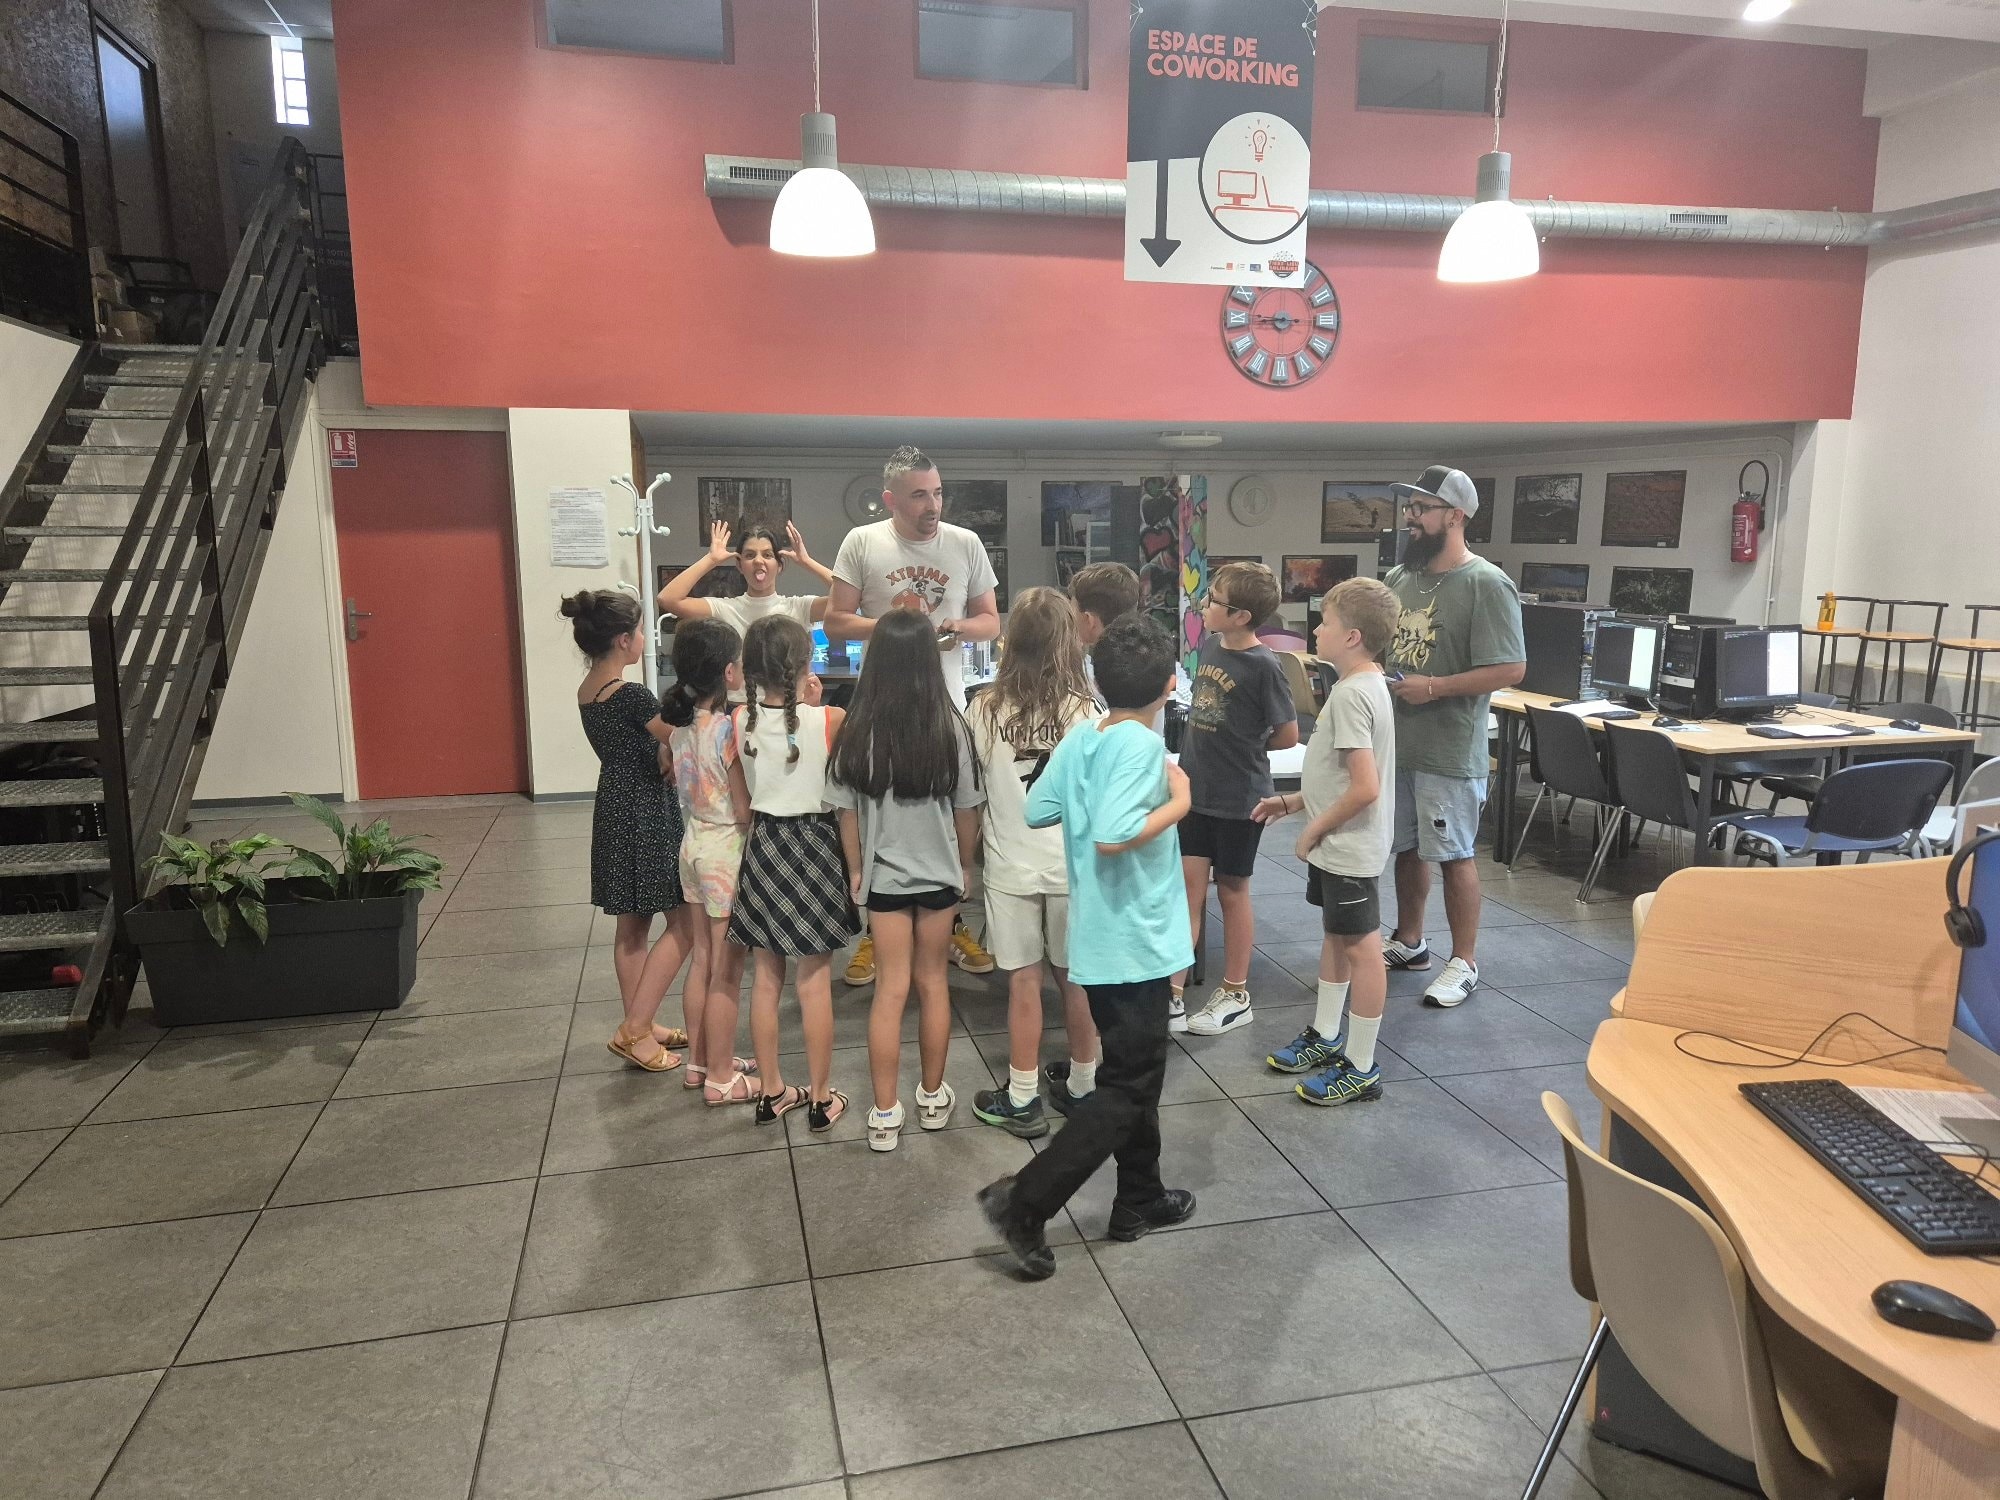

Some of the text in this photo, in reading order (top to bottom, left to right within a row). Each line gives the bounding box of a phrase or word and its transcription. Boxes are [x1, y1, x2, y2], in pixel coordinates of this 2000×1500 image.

[1148, 29, 1258, 58] ESPACE DE
[1147, 52, 1299, 87] COWORKING
[1230, 311, 1246, 324] IX
[1320, 315, 1334, 325] III
[886, 566, 950, 587] XTREME
[1197, 664, 1236, 693] UNGLE
